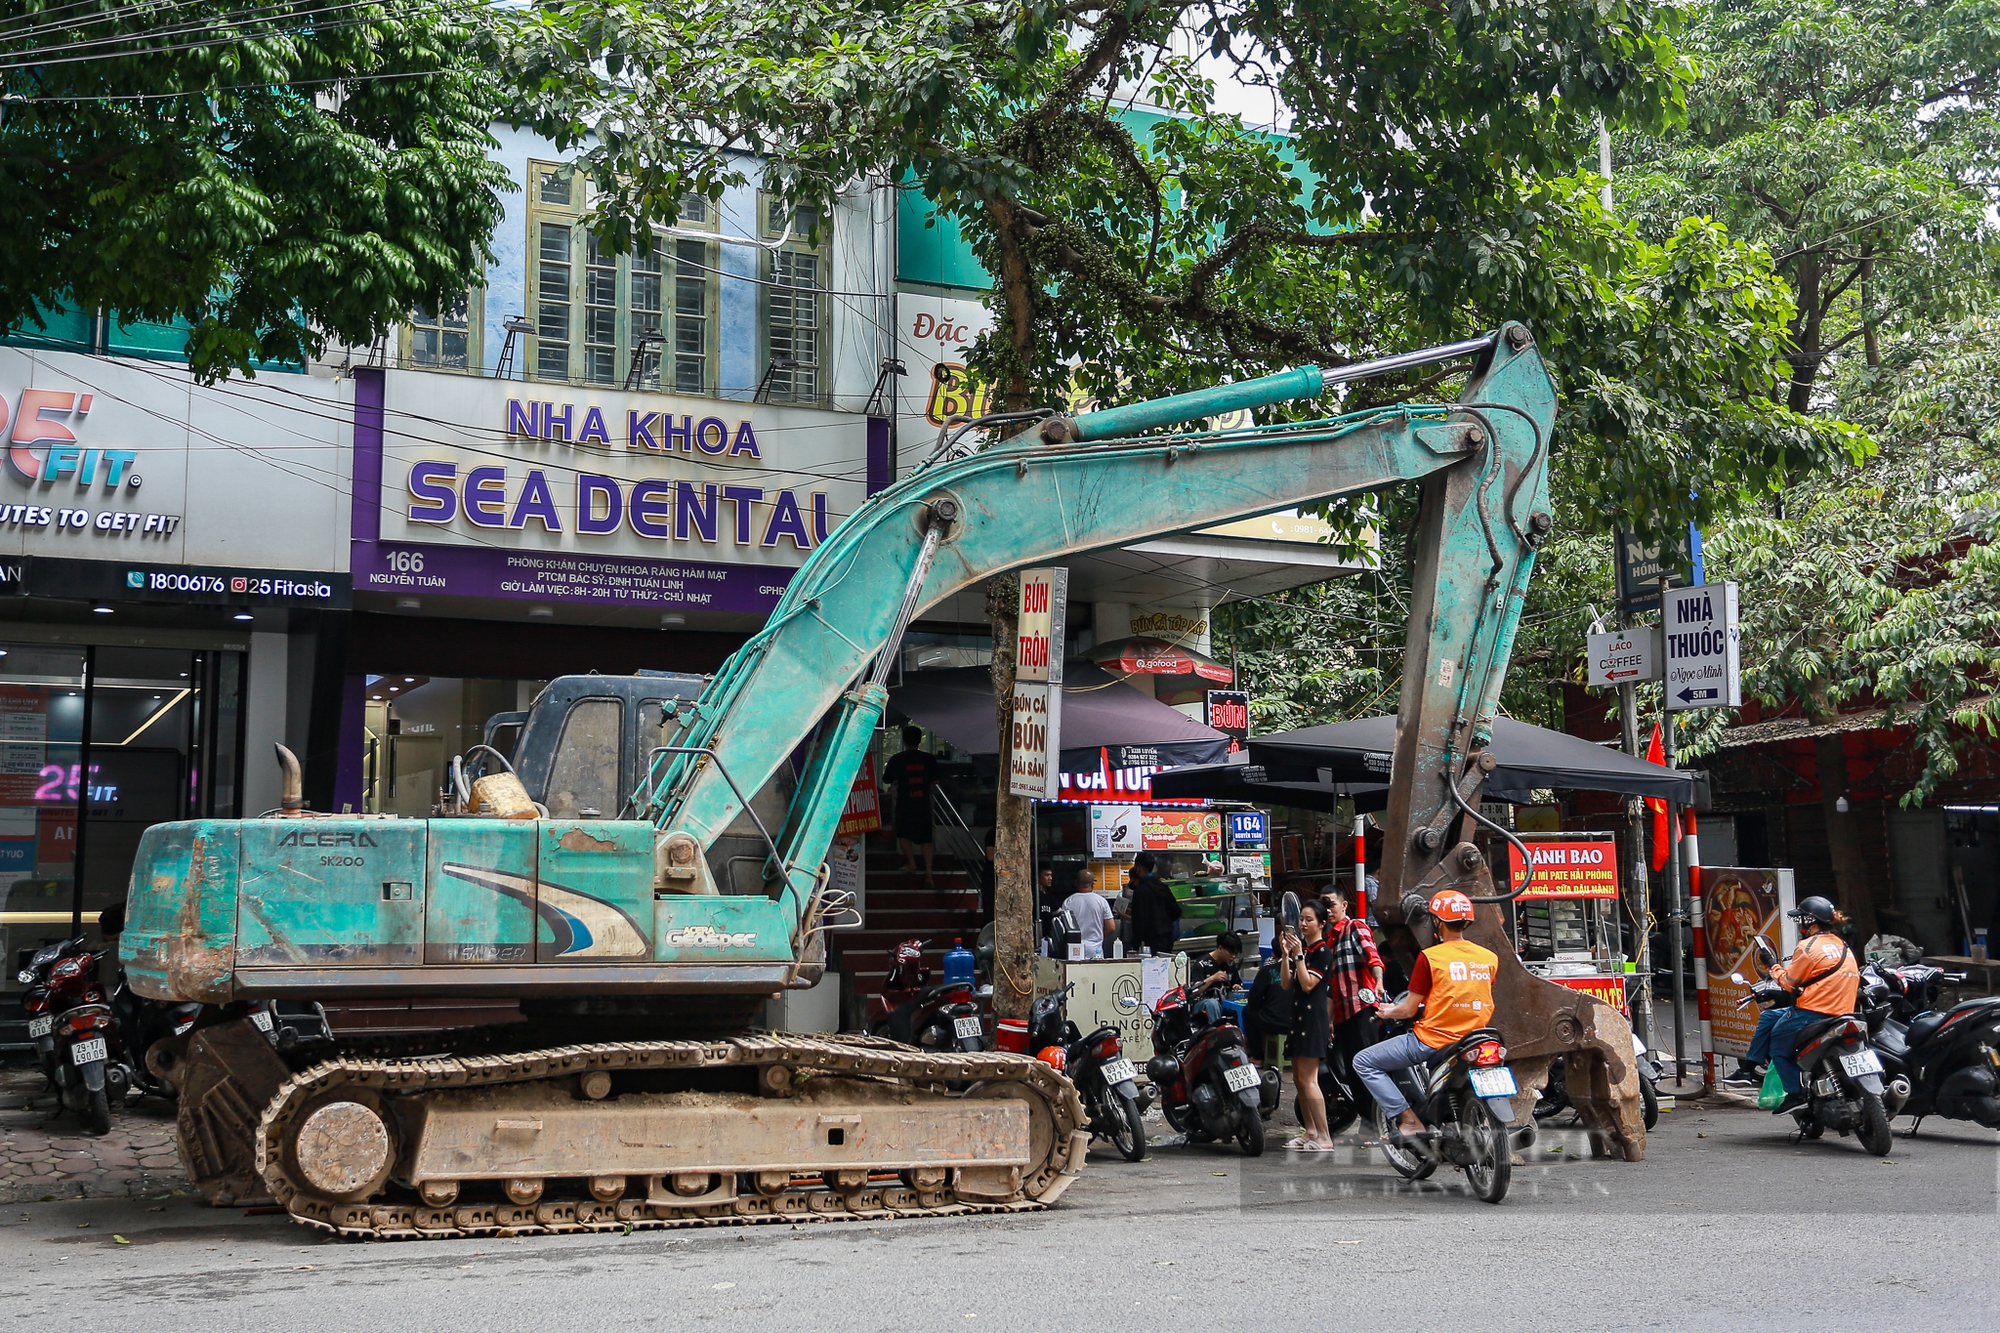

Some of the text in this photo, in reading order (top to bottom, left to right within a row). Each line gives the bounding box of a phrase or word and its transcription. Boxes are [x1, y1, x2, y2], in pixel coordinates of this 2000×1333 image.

[913, 313, 969, 347] Đặc
[507, 398, 762, 459] NHA KHOA
[44, 444, 137, 486] FIT
[408, 460, 563, 532] SEA
[58, 508, 89, 528] TO
[95, 511, 140, 531] GET
[144, 514, 180, 534] FIT
[386, 551, 424, 573] 166
[507, 556, 544, 569] PHÒNG
[546, 559, 576, 570] KHÁM
[620, 565, 649, 575] KHOA
[150, 572, 225, 592] 18006176
[369, 572, 446, 587] NGUYỄN TUÂN
[522, 582, 545, 594] LÀM
[537, 572, 566, 582] PTCM
[569, 573, 590, 584] BÁC
[662, 580, 684, 589] LINH
[1024, 576, 1049, 614] BÚN
[1677, 590, 1714, 624] NHÀ
[1130, 615, 1153, 634] BÚN
[1609, 641, 1633, 652] LACO
[1668, 622, 1724, 659] THUỐC
[1019, 630, 1049, 674] TRỘN
[1147, 660, 1177, 668] gofood
[1696, 664, 1724, 680] Minh
[1014, 692, 1046, 714] BÚN CÁ
[1692, 690, 1707, 698] 5M
[1212, 699, 1246, 729] BÚN
[1013, 715, 1046, 753] BÚN
[1012, 756, 1044, 779] HẢI SẢN
[850, 785, 876, 814] PHÒNG
[1234, 816, 1261, 831] 164
[278, 831, 378, 848] ACERA
[320, 855, 365, 867] SK200
[1570, 849, 1603, 864] BAO
[1538, 869, 1548, 880] MÌ
[1550, 871, 1568, 880] PATE
[1570, 868, 1584, 880] HẢI
[1585, 870, 1613, 880] PHÒNG
[75, 1049, 105, 1063] 490.09
[1105, 1059, 1129, 1073] 89-E1
